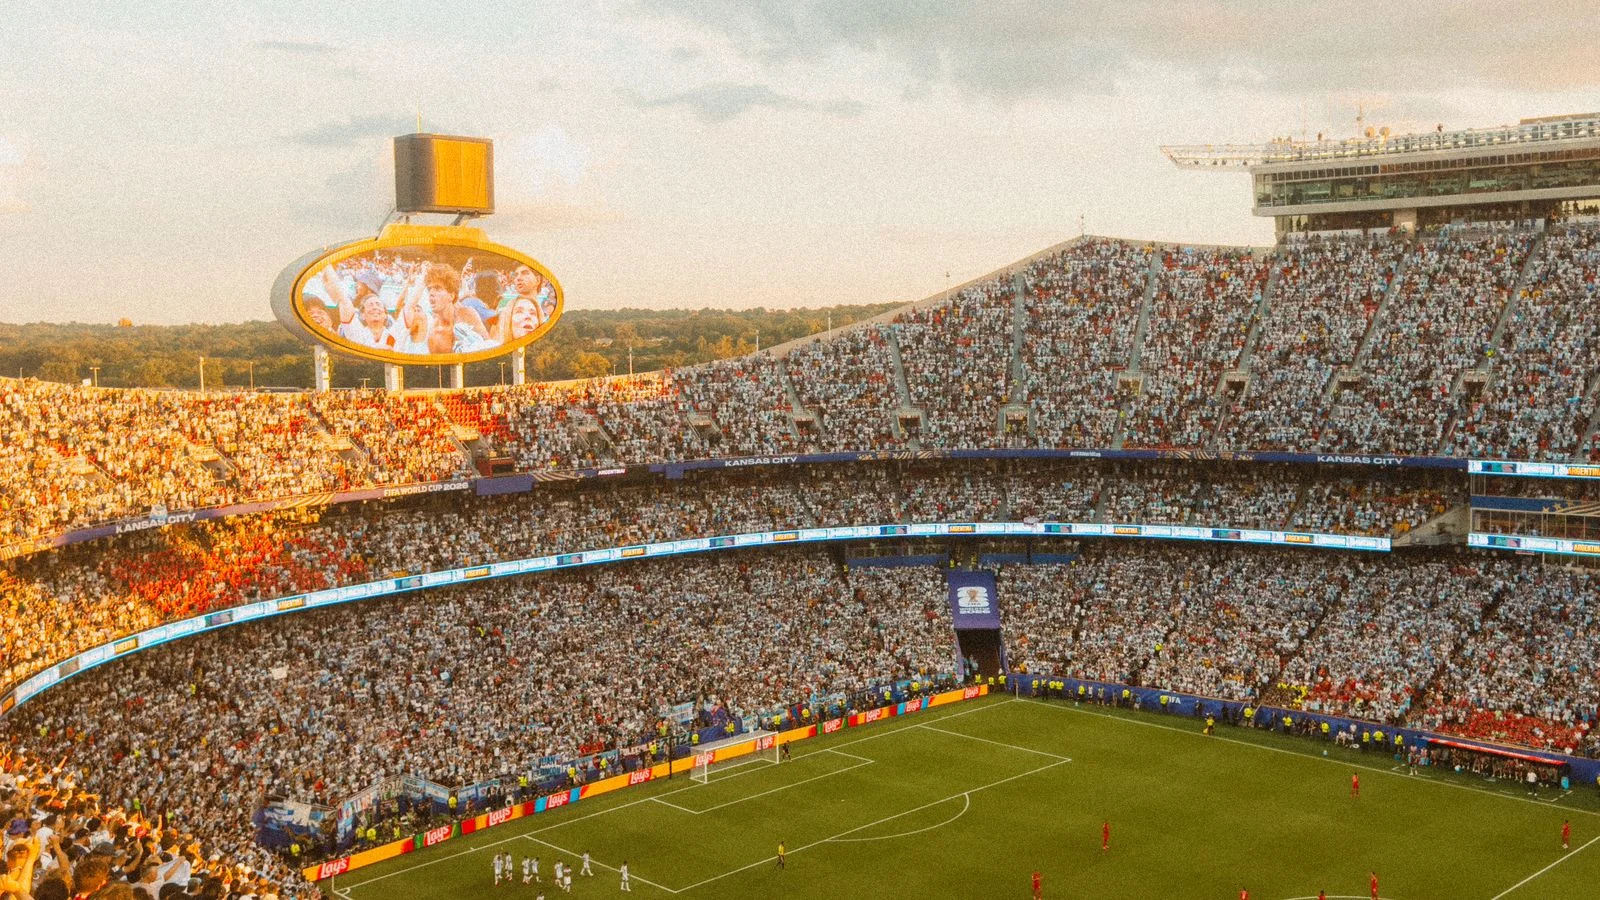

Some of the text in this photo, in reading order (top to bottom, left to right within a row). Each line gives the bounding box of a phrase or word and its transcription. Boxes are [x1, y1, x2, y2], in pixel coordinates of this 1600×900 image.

[725, 458, 770, 467] KANSAS
[1317, 455, 1404, 465] KANSAS CITY
[1567, 467, 1600, 476] ARGENTIN
[384, 488, 400, 497] FIFA
[400, 485, 427, 495] WORLD
[428, 484, 443, 492] CUP
[116, 513, 196, 534] KANSAS CITY
[1168, 696, 1181, 704] IFA
